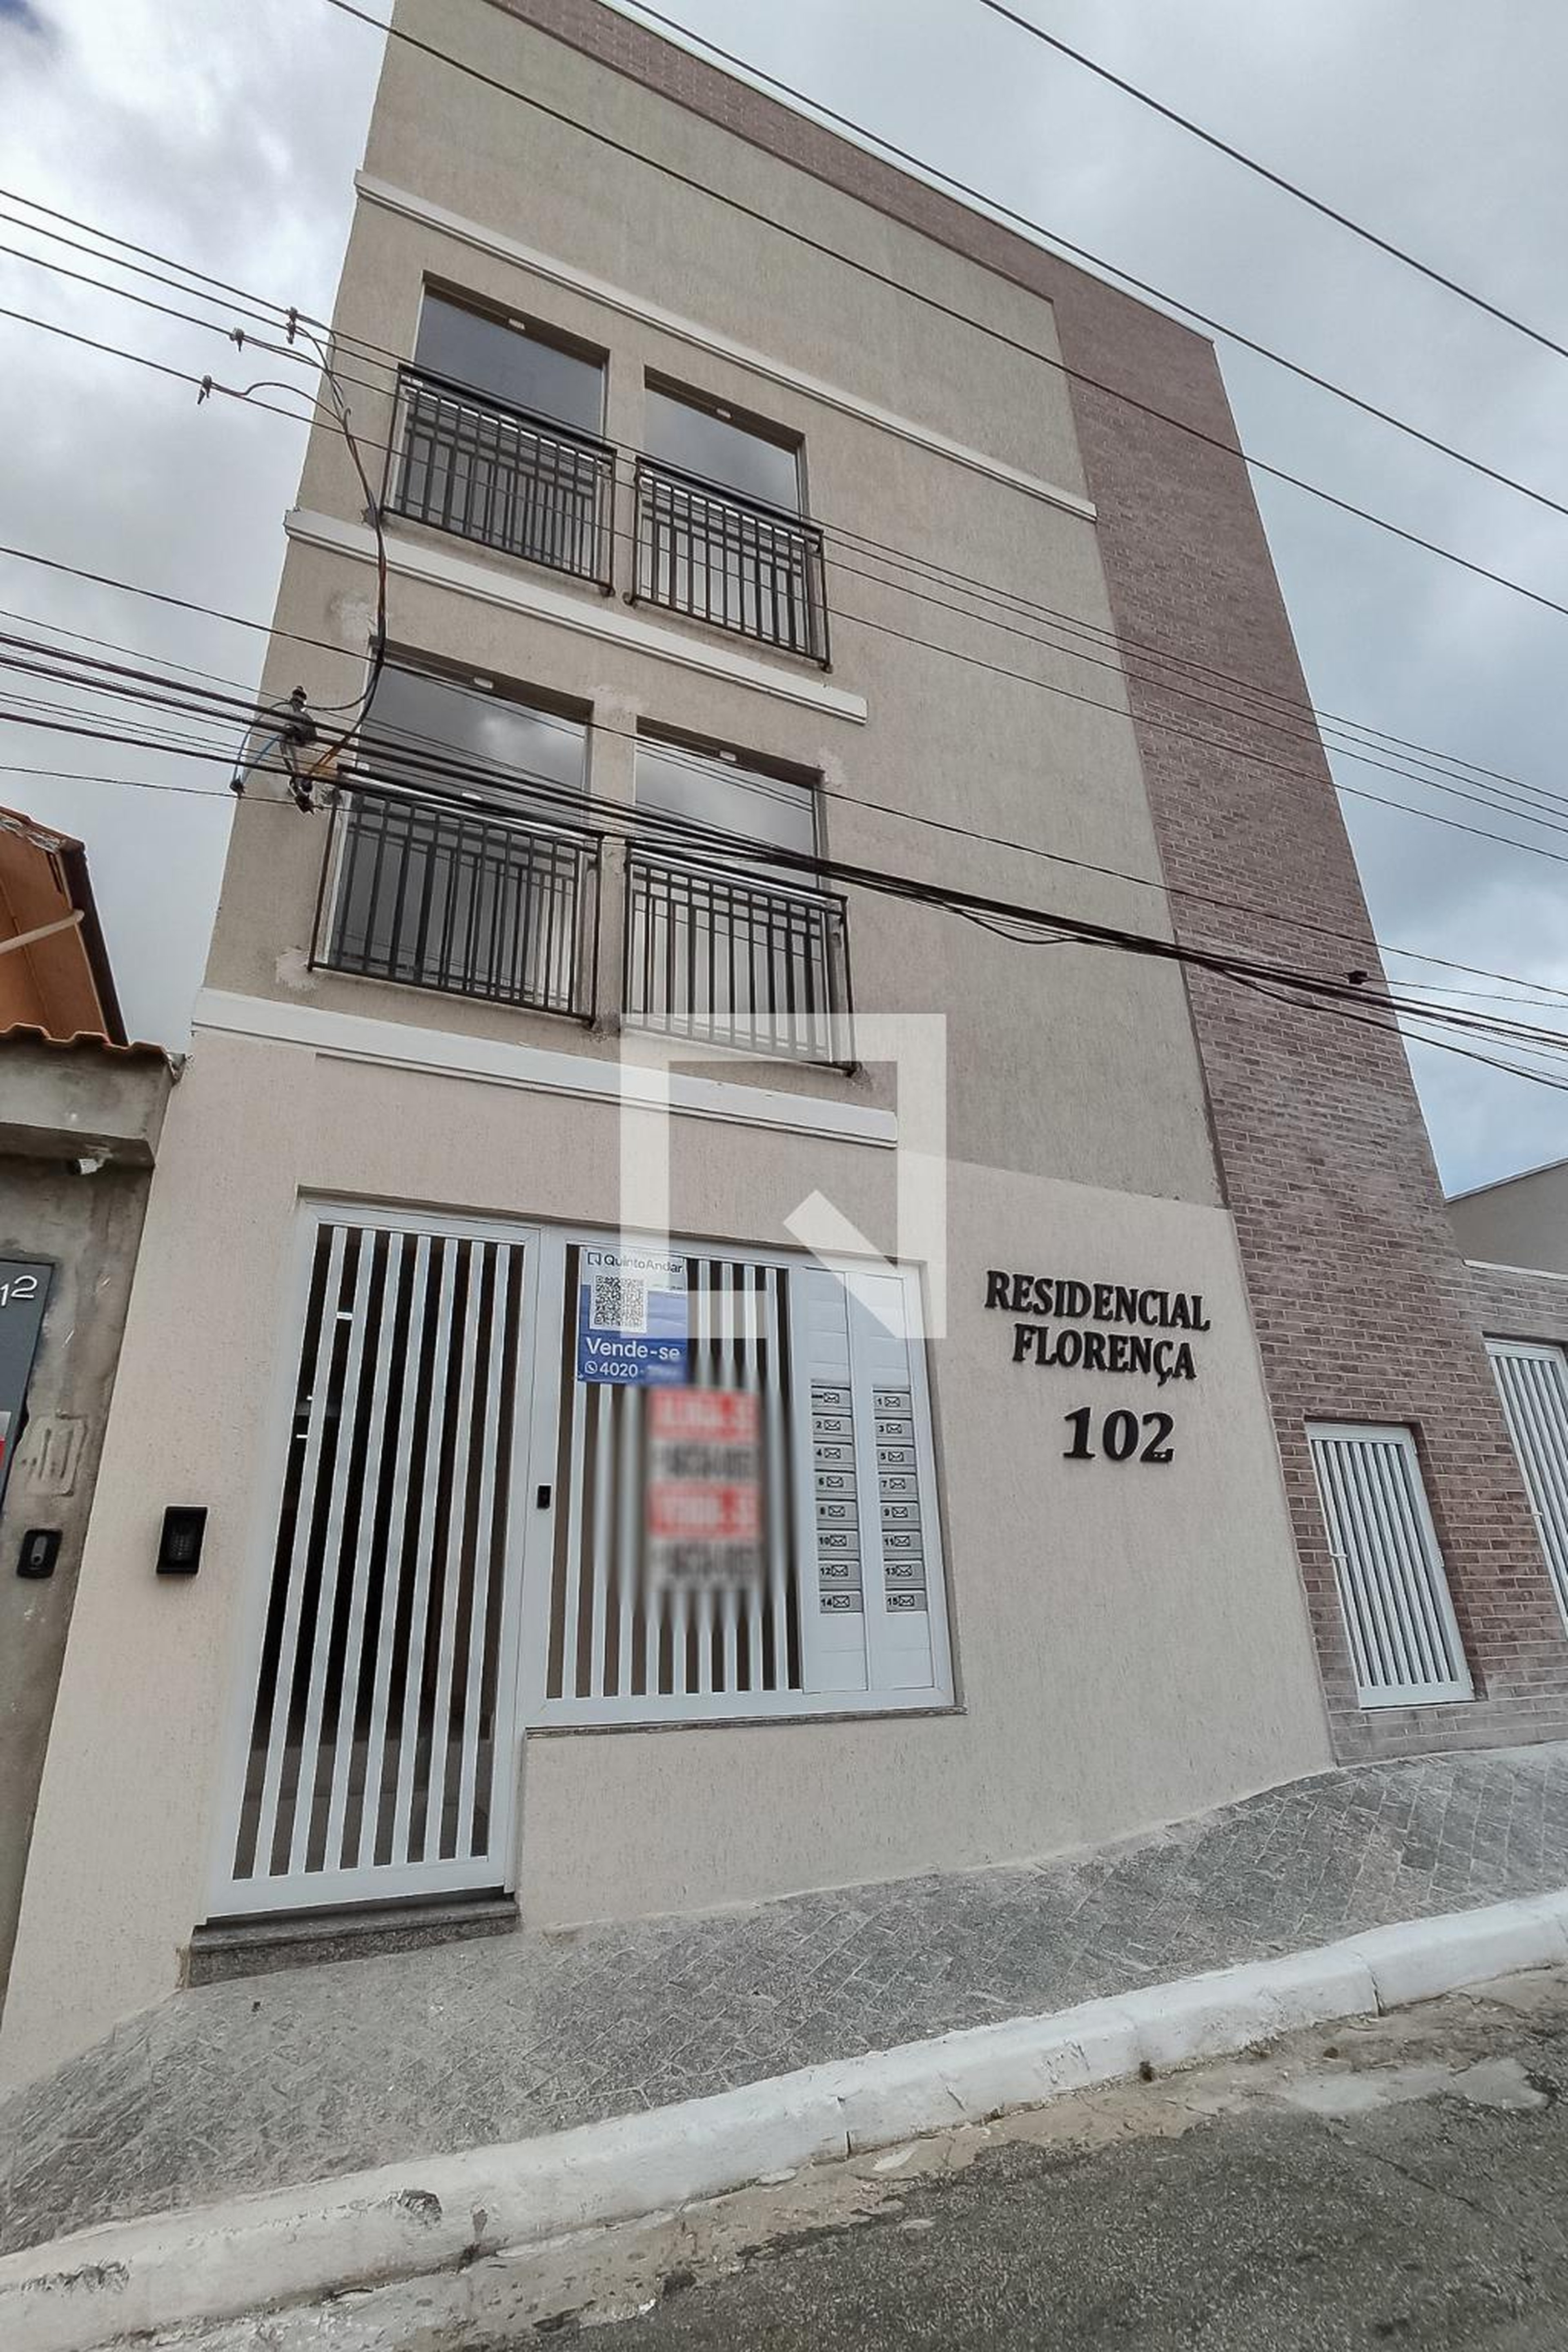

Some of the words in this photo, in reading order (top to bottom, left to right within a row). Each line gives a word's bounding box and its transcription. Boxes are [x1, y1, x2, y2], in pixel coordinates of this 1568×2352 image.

[604, 1254, 683, 1273] QuintoAndar
[984, 1270, 1211, 1331] RESIDENCIAL
[586, 1337, 679, 1360] Vende-se
[1013, 1323, 1196, 1386] FLORENÇA
[1063, 1407, 1174, 1462] 102
[819, 1537, 830, 1545] 10
